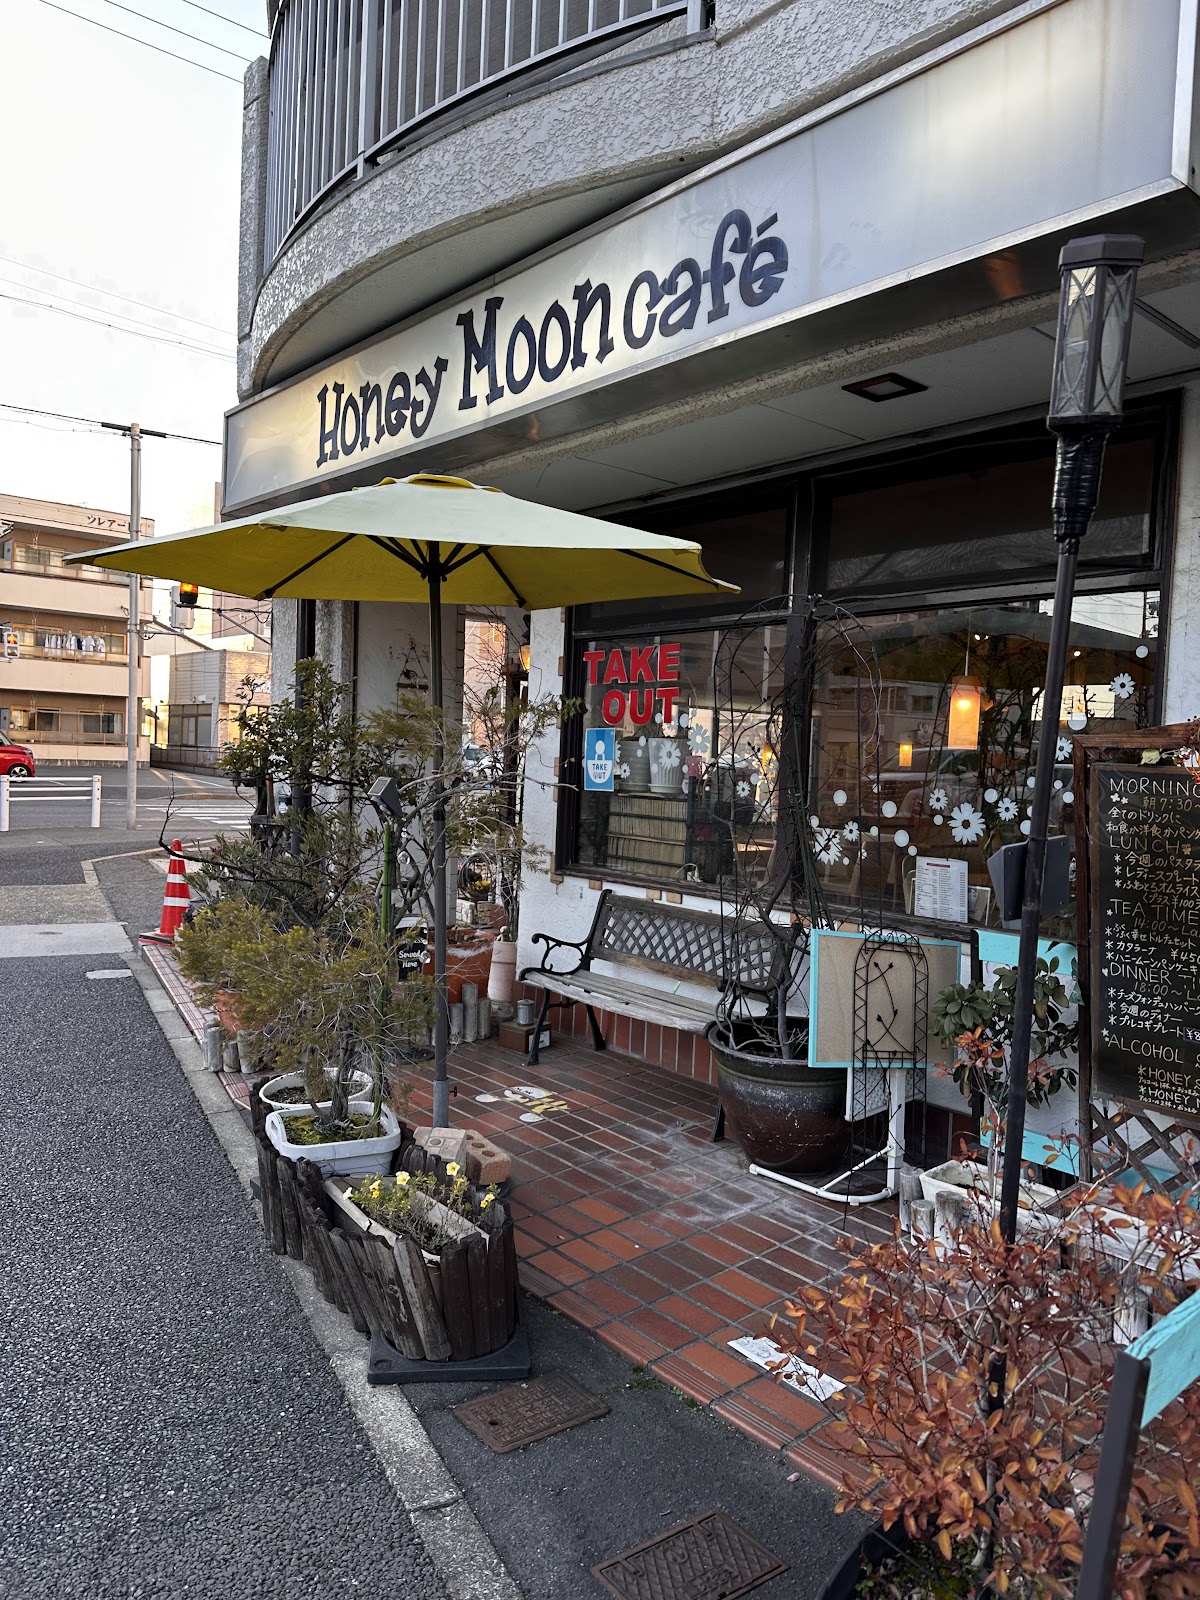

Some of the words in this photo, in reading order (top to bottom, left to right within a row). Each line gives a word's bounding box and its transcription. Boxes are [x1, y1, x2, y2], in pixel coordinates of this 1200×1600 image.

[315, 356, 448, 468] Honey
[456, 277, 615, 411] Moon
[623, 208, 789, 349] café
[583, 642, 681, 685] TAKE
[601, 686, 680, 725] OUT
[592, 763, 608, 771] TAKE
[1108, 806, 1181, 824] 全てのドリンクに
[1110, 835, 1180, 854] LUNCH
[1126, 866, 1200, 885] レディースプレート
[1123, 880, 1200, 897] ふわとろオムライス
[1110, 899, 1146, 918] TEA
[1151, 905, 1200, 925] TIME
[1117, 941, 1157, 955] カタラーナ
[1110, 962, 1172, 985] DINNER
[1115, 954, 1198, 975] ハニームーンパンケーキ
[1120, 1002, 1182, 1023] 今週のディナー
[1119, 1015, 1184, 1037] プルコギプレート
[1108, 1034, 1184, 1064] ALCOHOL
[1149, 1067, 1191, 1087] HONEY
[1148, 1087, 1190, 1105] HONEY
